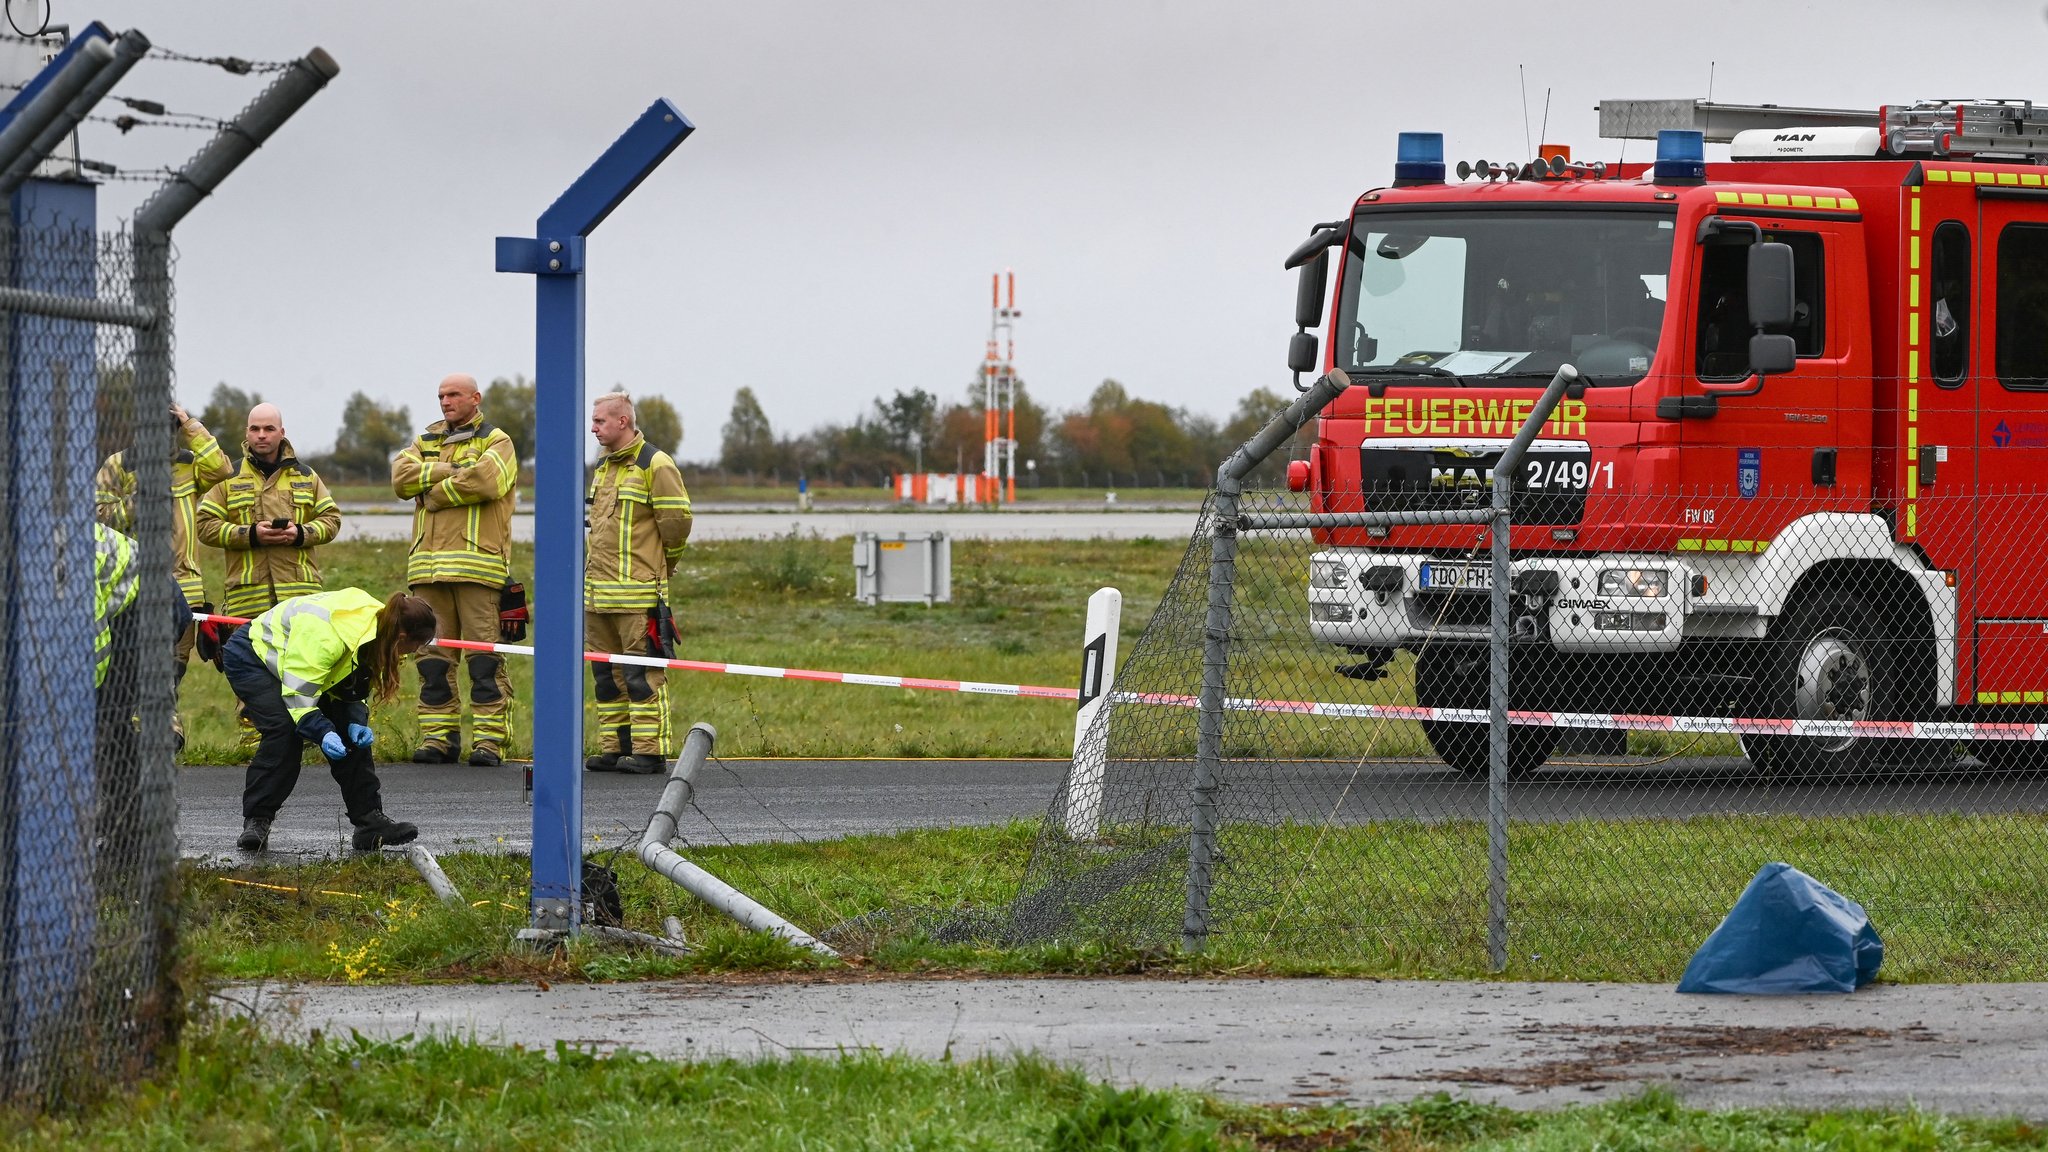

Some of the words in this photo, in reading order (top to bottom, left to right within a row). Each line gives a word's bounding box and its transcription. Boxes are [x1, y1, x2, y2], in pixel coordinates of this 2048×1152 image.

[1773, 134, 1816, 142] MAN
[1527, 460, 1615, 489] 2/49/1
[1685, 508, 1701, 524] FW
